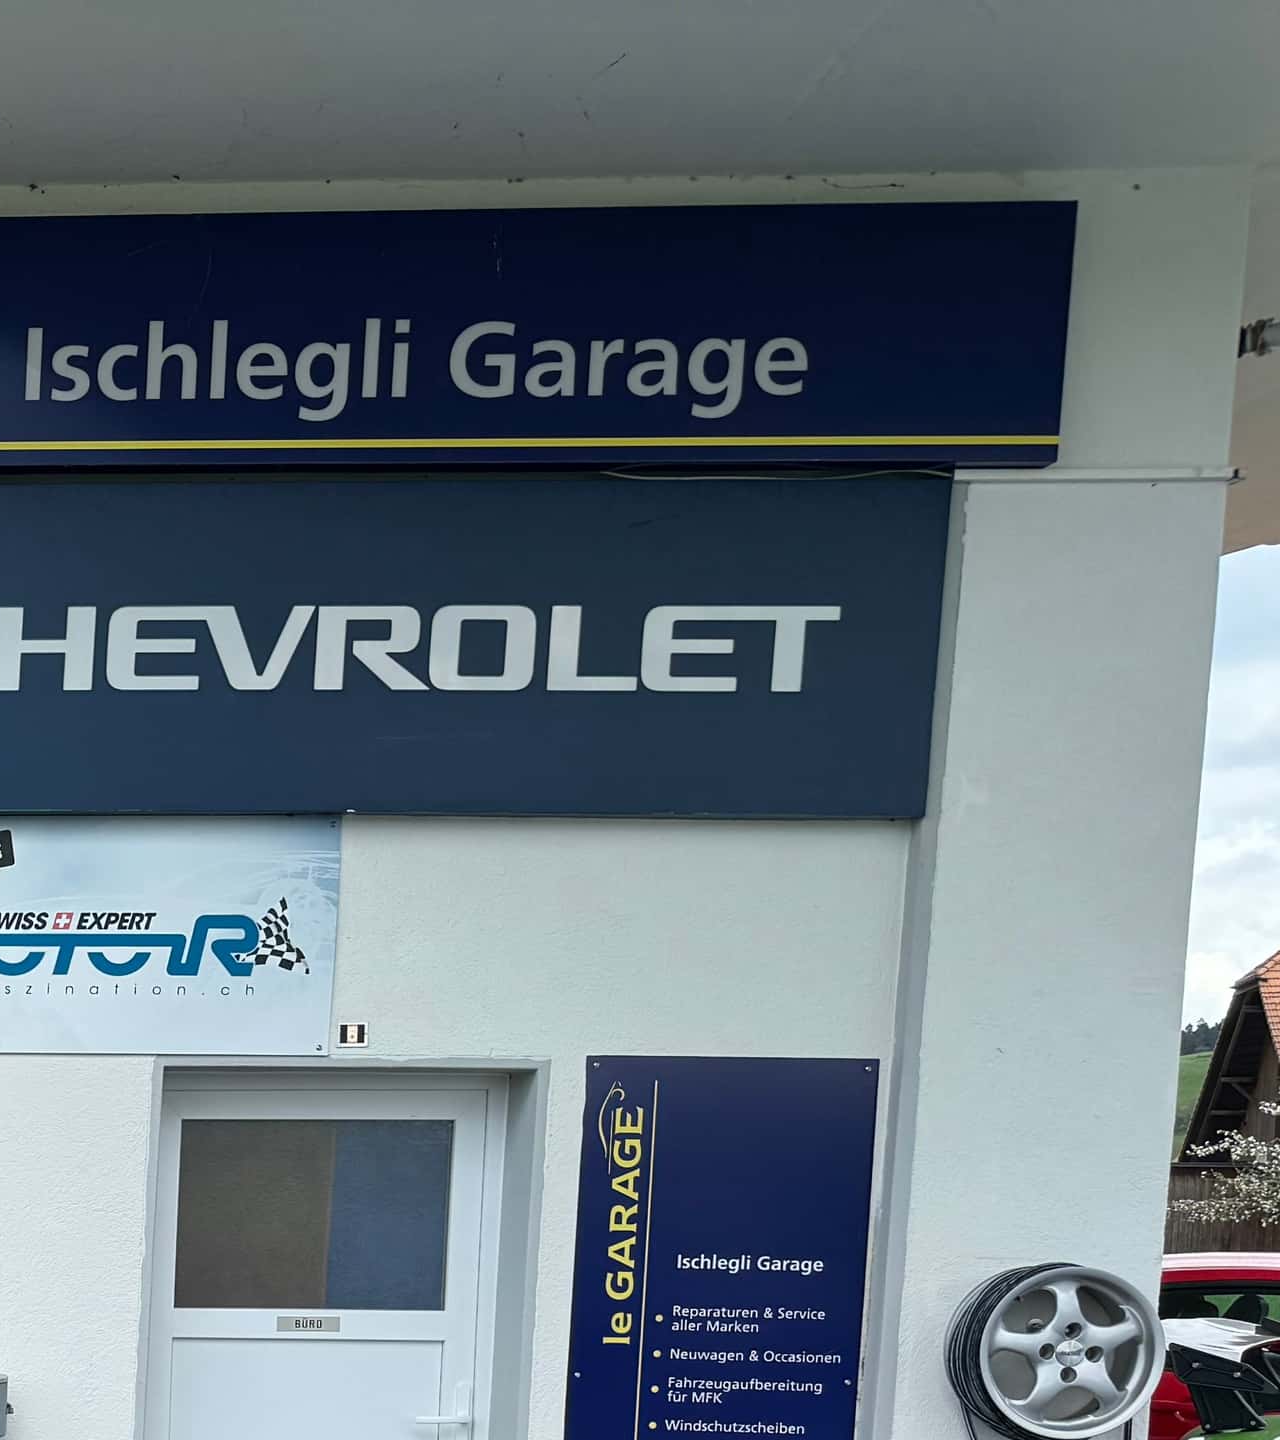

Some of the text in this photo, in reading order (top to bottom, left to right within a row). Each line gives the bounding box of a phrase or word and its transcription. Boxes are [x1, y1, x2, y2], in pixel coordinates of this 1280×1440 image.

[24, 319, 809, 421] Ischlegli Garage
[76, 911, 156, 931] EXPERT
[603, 1106, 644, 1344] le GARAGE
[676, 1254, 824, 1275] Ischlegli Garage
[672, 1306, 826, 1321] Reparaturen & Service
[671, 1320, 759, 1333] aller Marken
[669, 1348, 841, 1364] Neuwagen & Occasionen
[668, 1377, 823, 1395] Fahrzeugaufbereitung
[667, 1391, 723, 1404] für MFK
[665, 1419, 805, 1435] Windschutzscheiben
